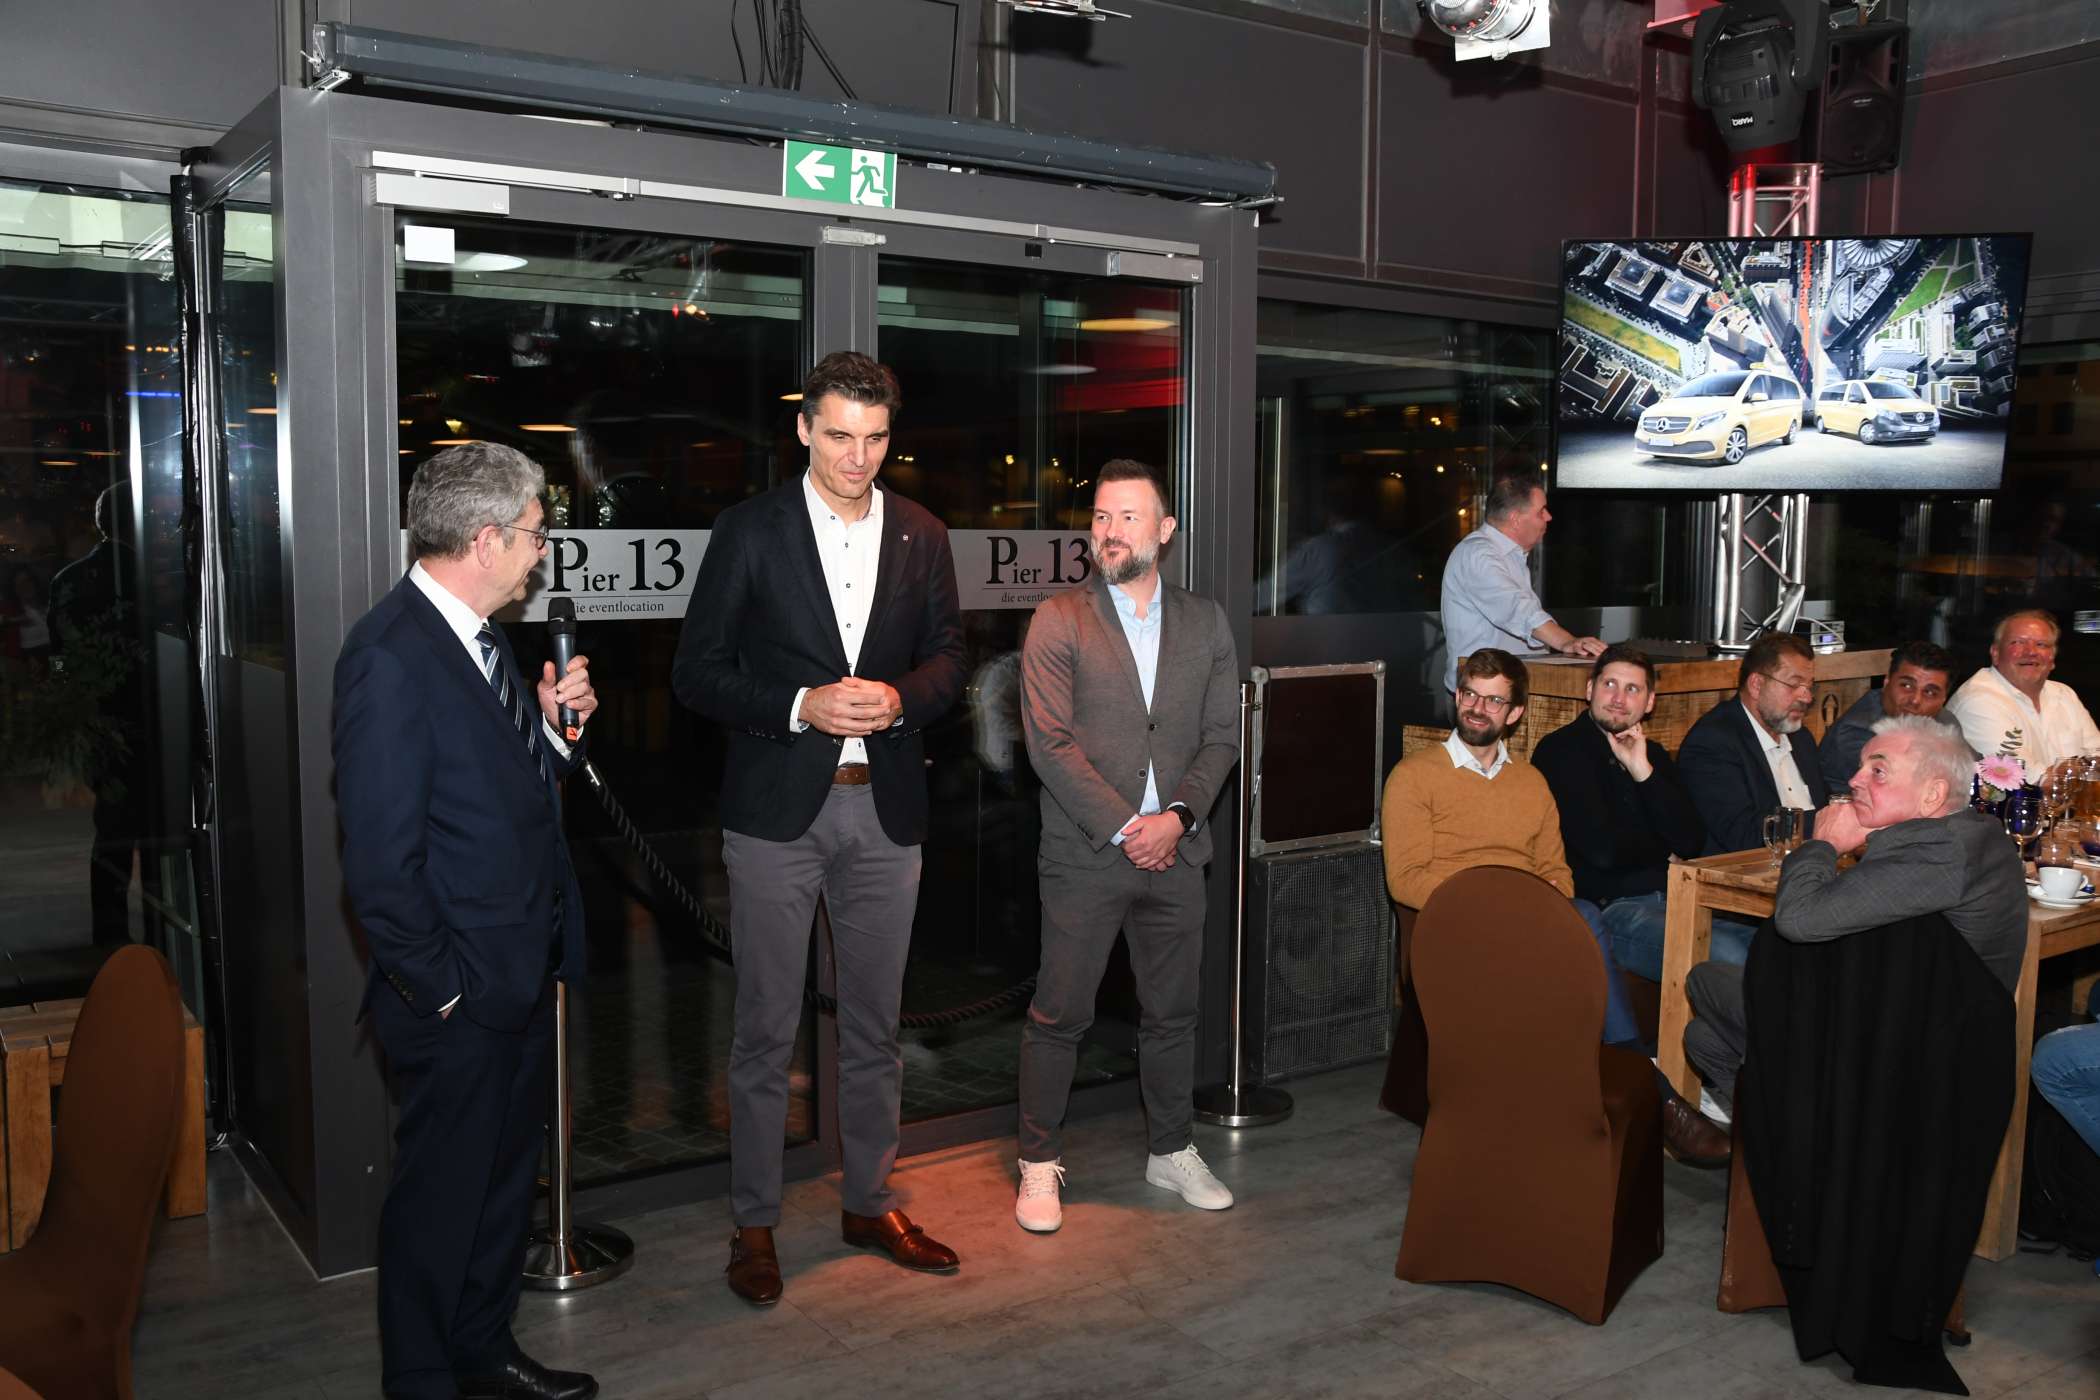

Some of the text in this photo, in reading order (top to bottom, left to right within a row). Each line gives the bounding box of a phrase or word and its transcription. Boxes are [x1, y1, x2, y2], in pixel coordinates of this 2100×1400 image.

[547, 537, 685, 592] Pier 13
[986, 536, 1091, 584] Pier 13
[575, 601, 664, 613] ie eventlocation
[1001, 591, 1015, 603] die
